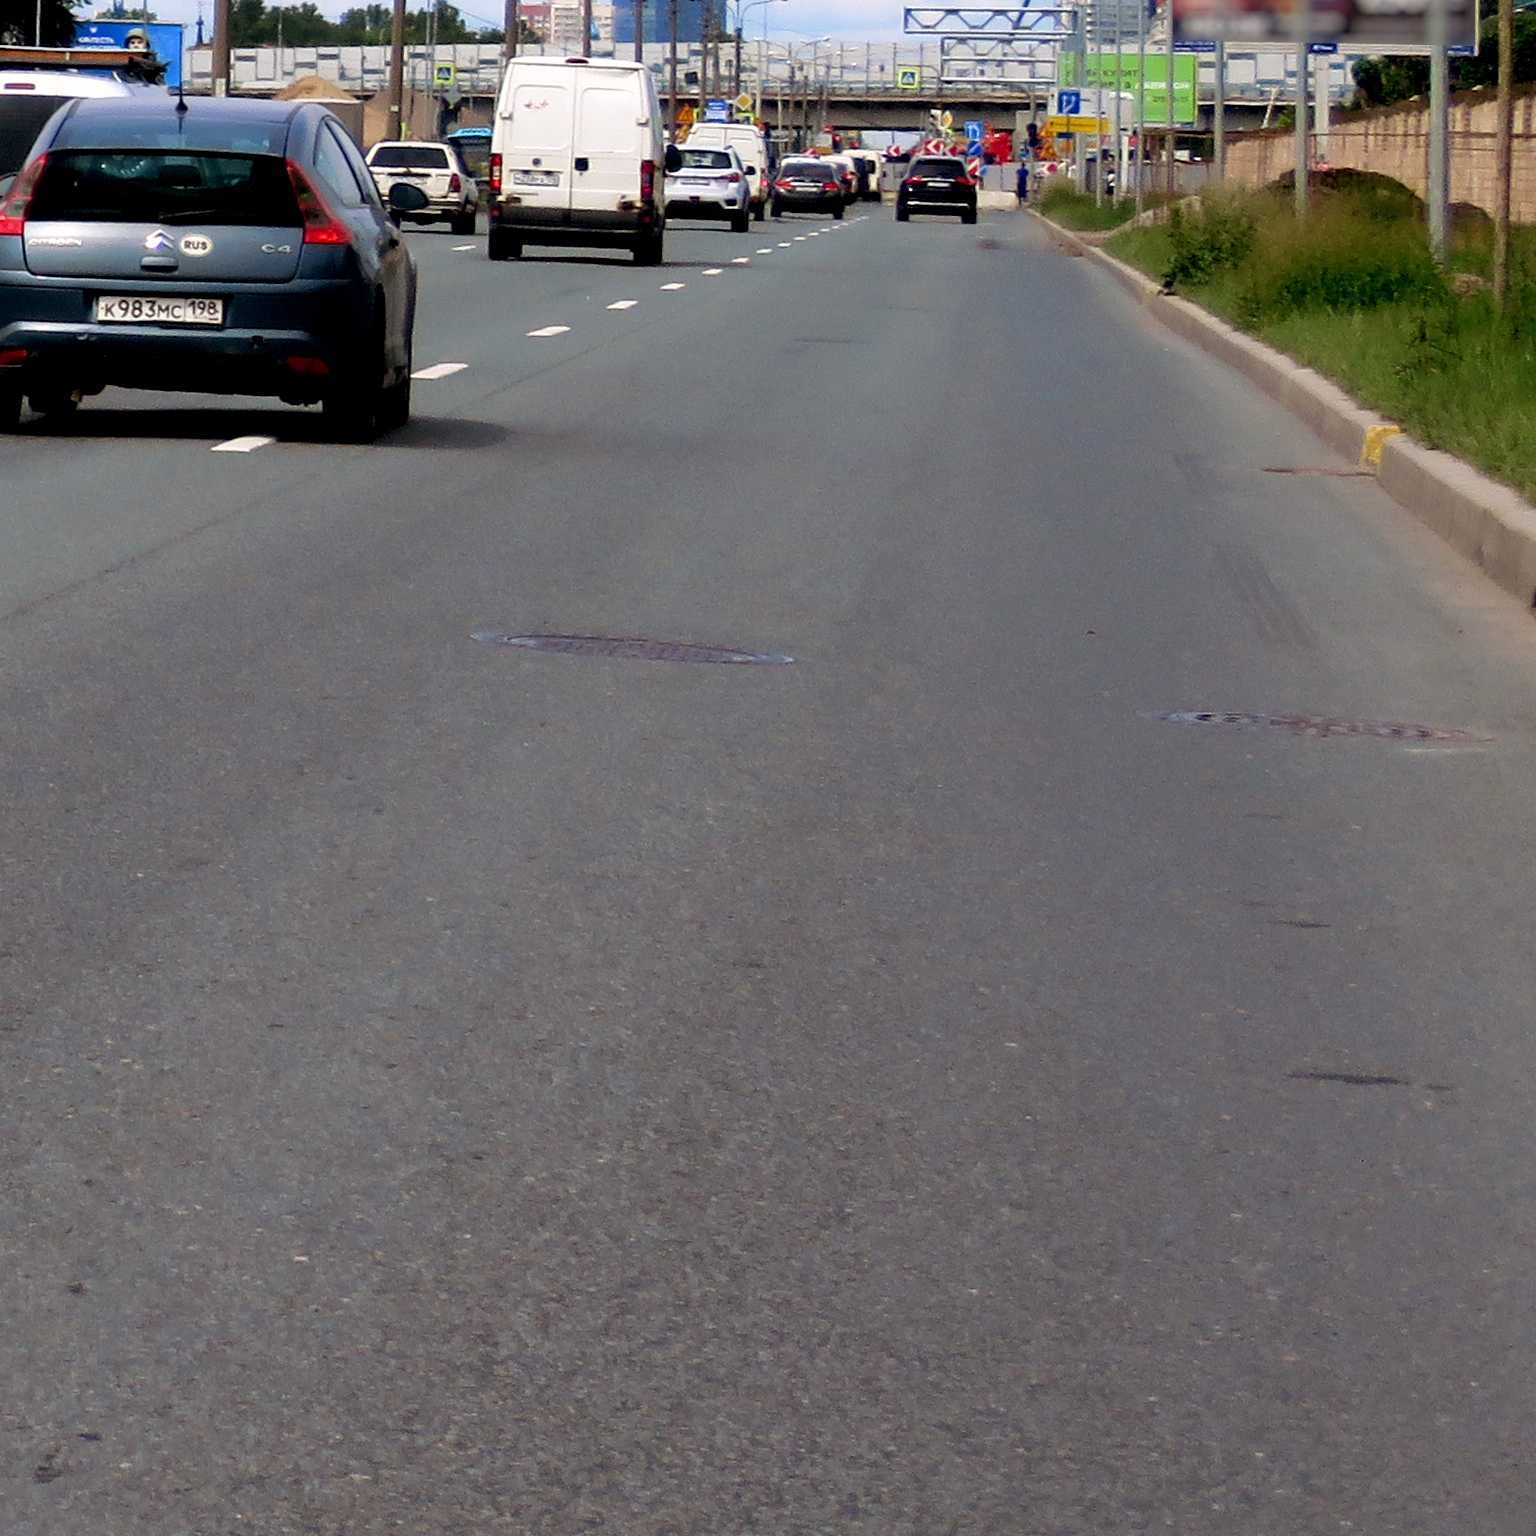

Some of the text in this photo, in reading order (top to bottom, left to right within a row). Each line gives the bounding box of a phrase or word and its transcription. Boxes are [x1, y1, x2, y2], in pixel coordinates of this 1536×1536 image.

[183, 240, 208, 251] RUS
[261, 243, 292, 254] C4
[103, 299, 219, 320] К983МС 198
